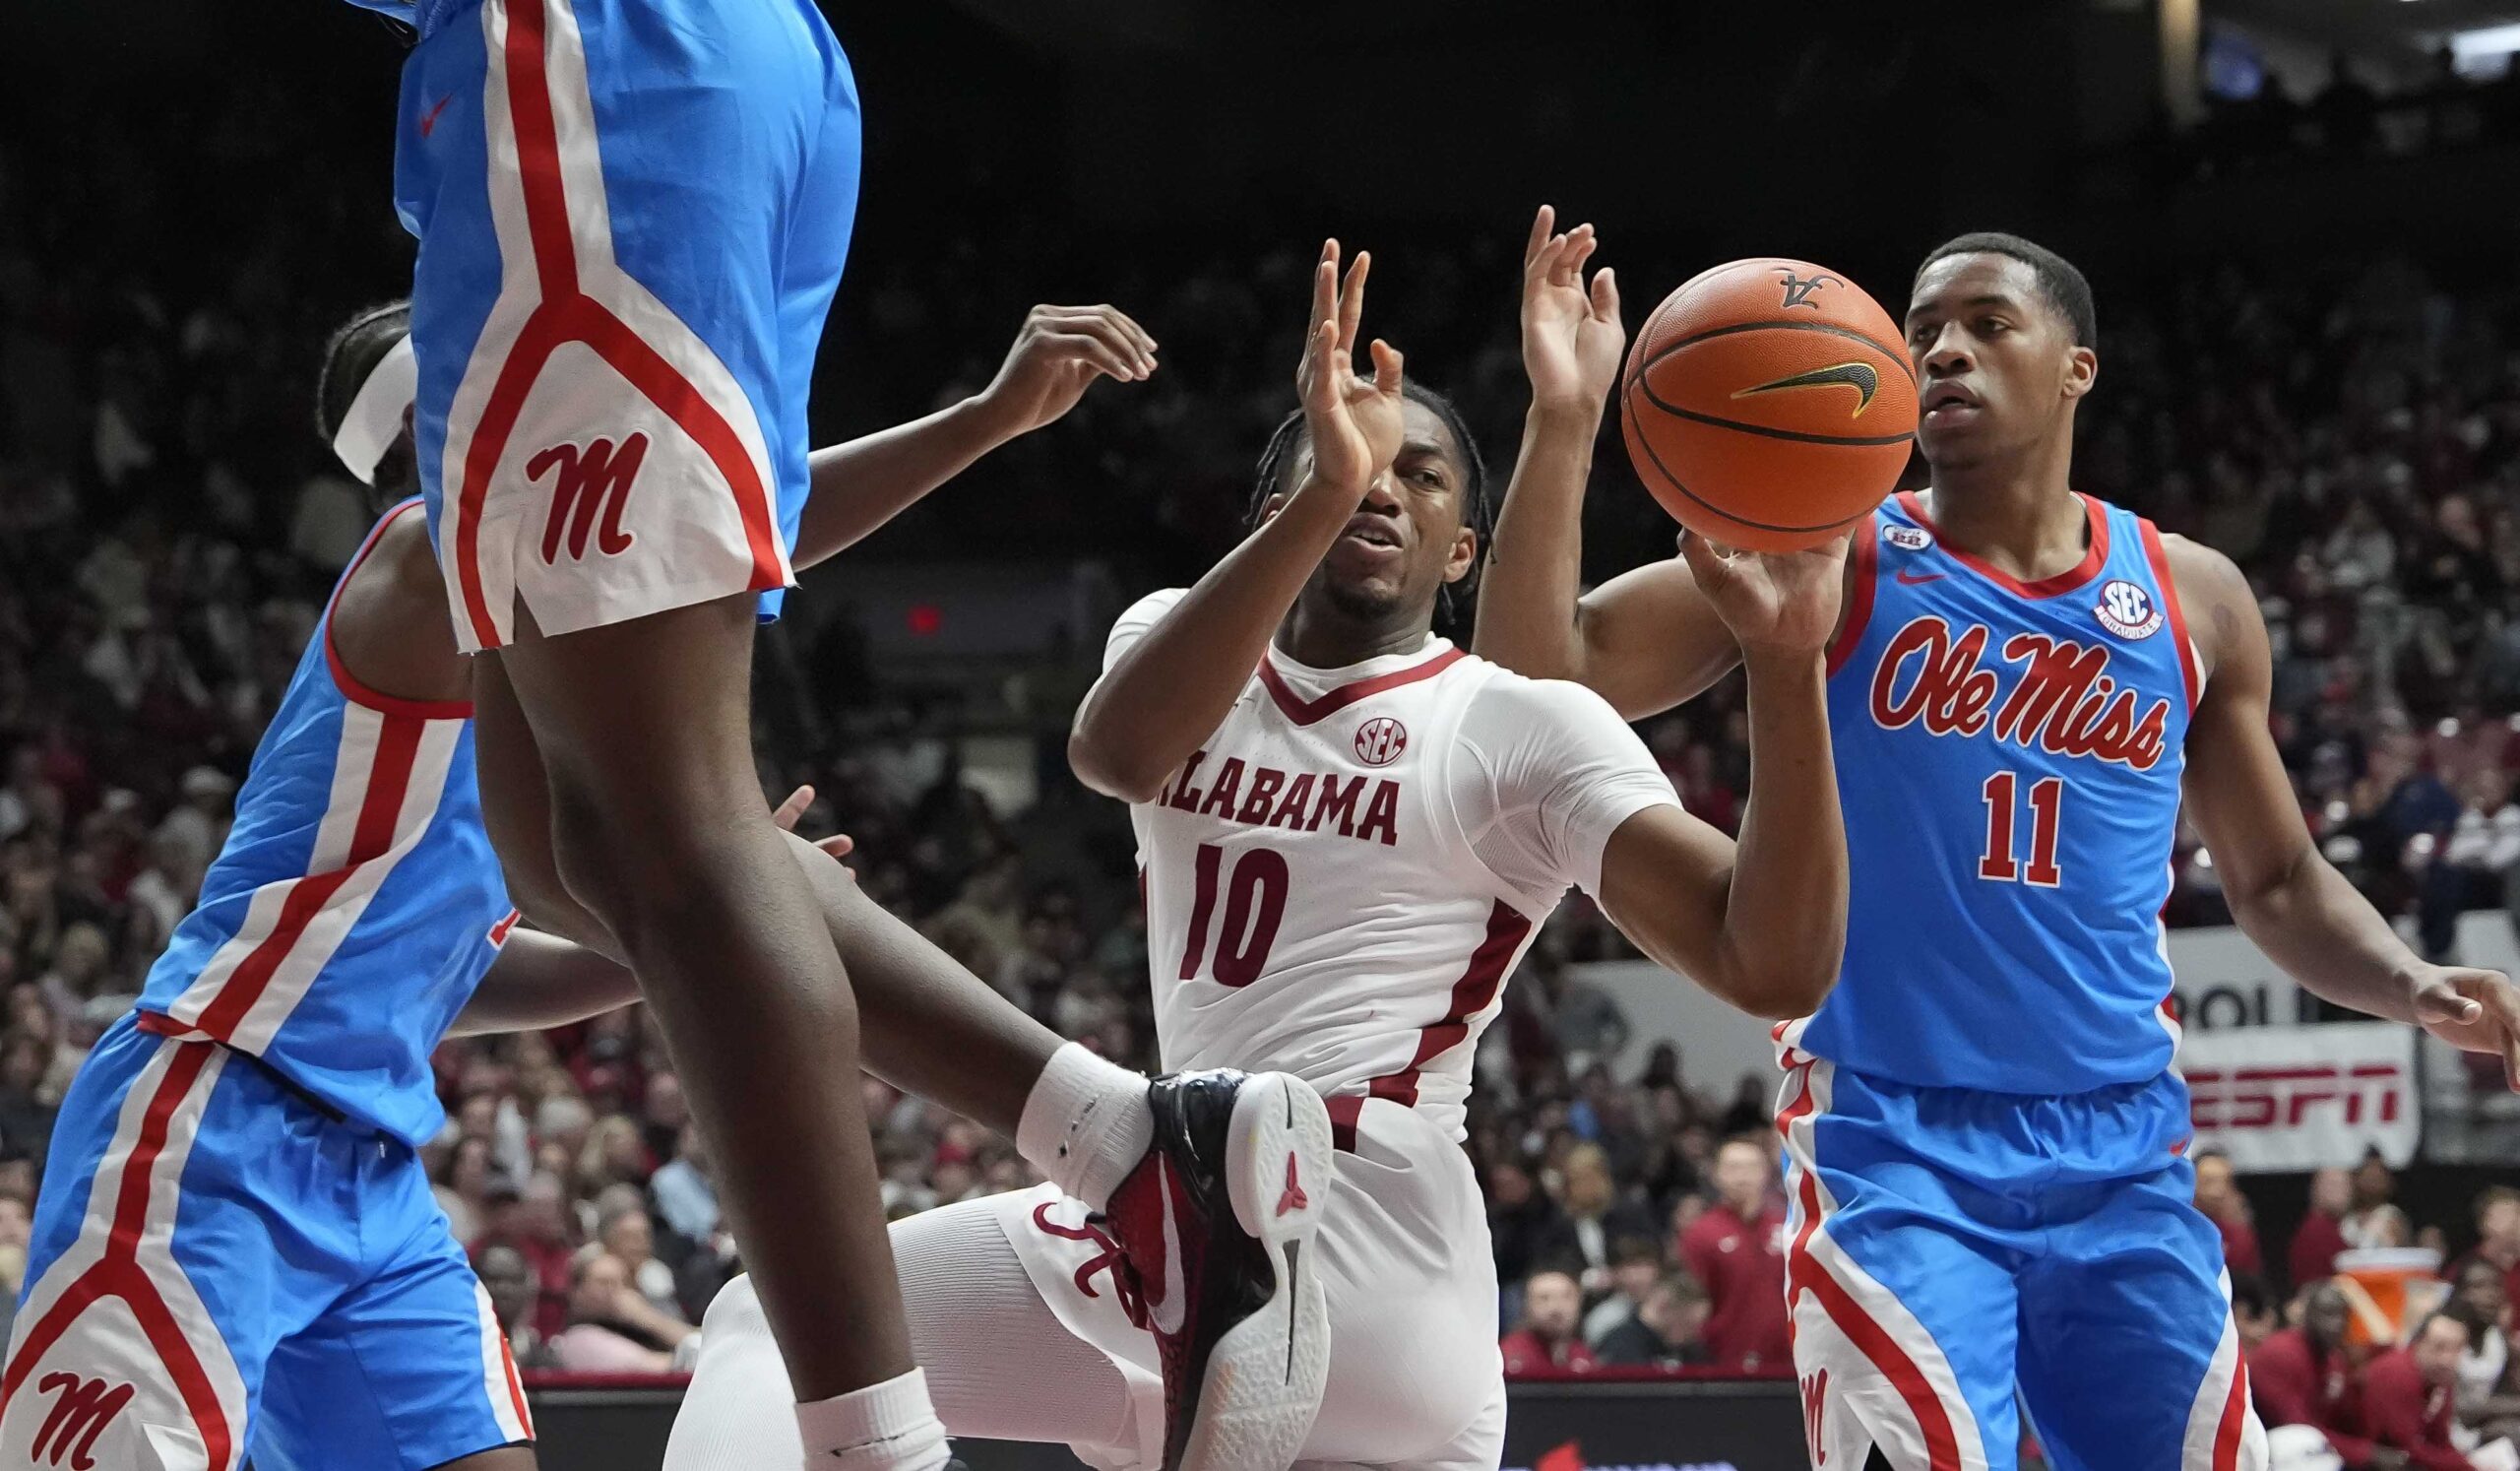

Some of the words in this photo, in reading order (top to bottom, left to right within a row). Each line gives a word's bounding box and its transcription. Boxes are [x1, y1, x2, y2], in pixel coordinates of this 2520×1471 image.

[524, 429, 651, 567] M
[2105, 582, 2149, 623] SEC
[1356, 719, 1406, 763] SEC
[1870, 615, 1997, 737] Ole
[1992, 634, 2171, 771] Miss
[1156, 749, 1401, 846] LABAMA
[1979, 770, 2063, 888] 11
[1178, 843, 1289, 988] 10
[2182, 1065, 2399, 1126] ESPN
[31, 1370, 136, 1471] M
